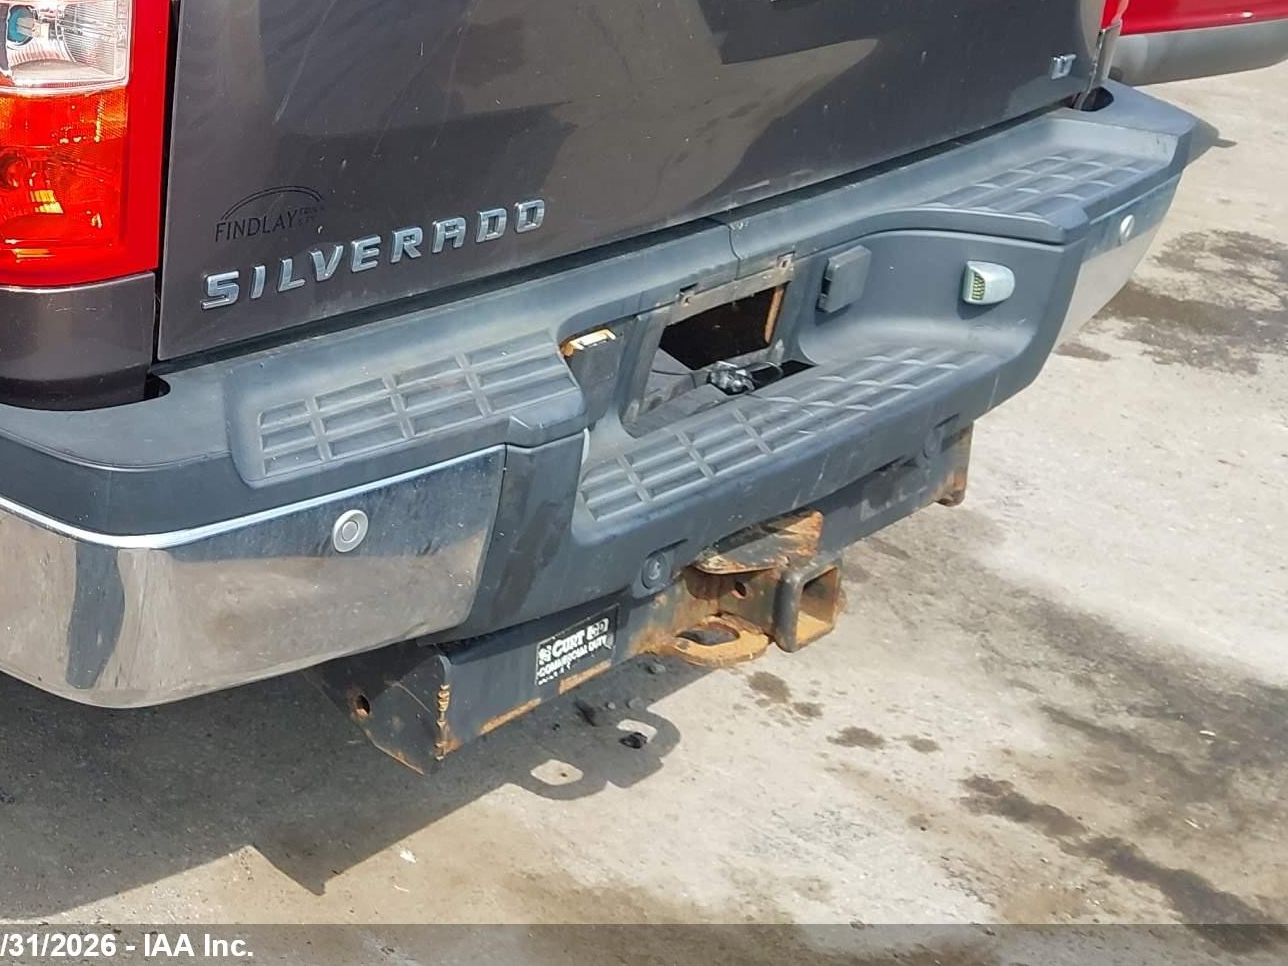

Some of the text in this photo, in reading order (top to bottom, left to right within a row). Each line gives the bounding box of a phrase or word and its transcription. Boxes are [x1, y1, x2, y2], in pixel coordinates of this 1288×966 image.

[215, 209, 298, 243] FINDLAY
[201, 199, 545, 311] SILVERADO
[552, 630, 586, 658] CURT
